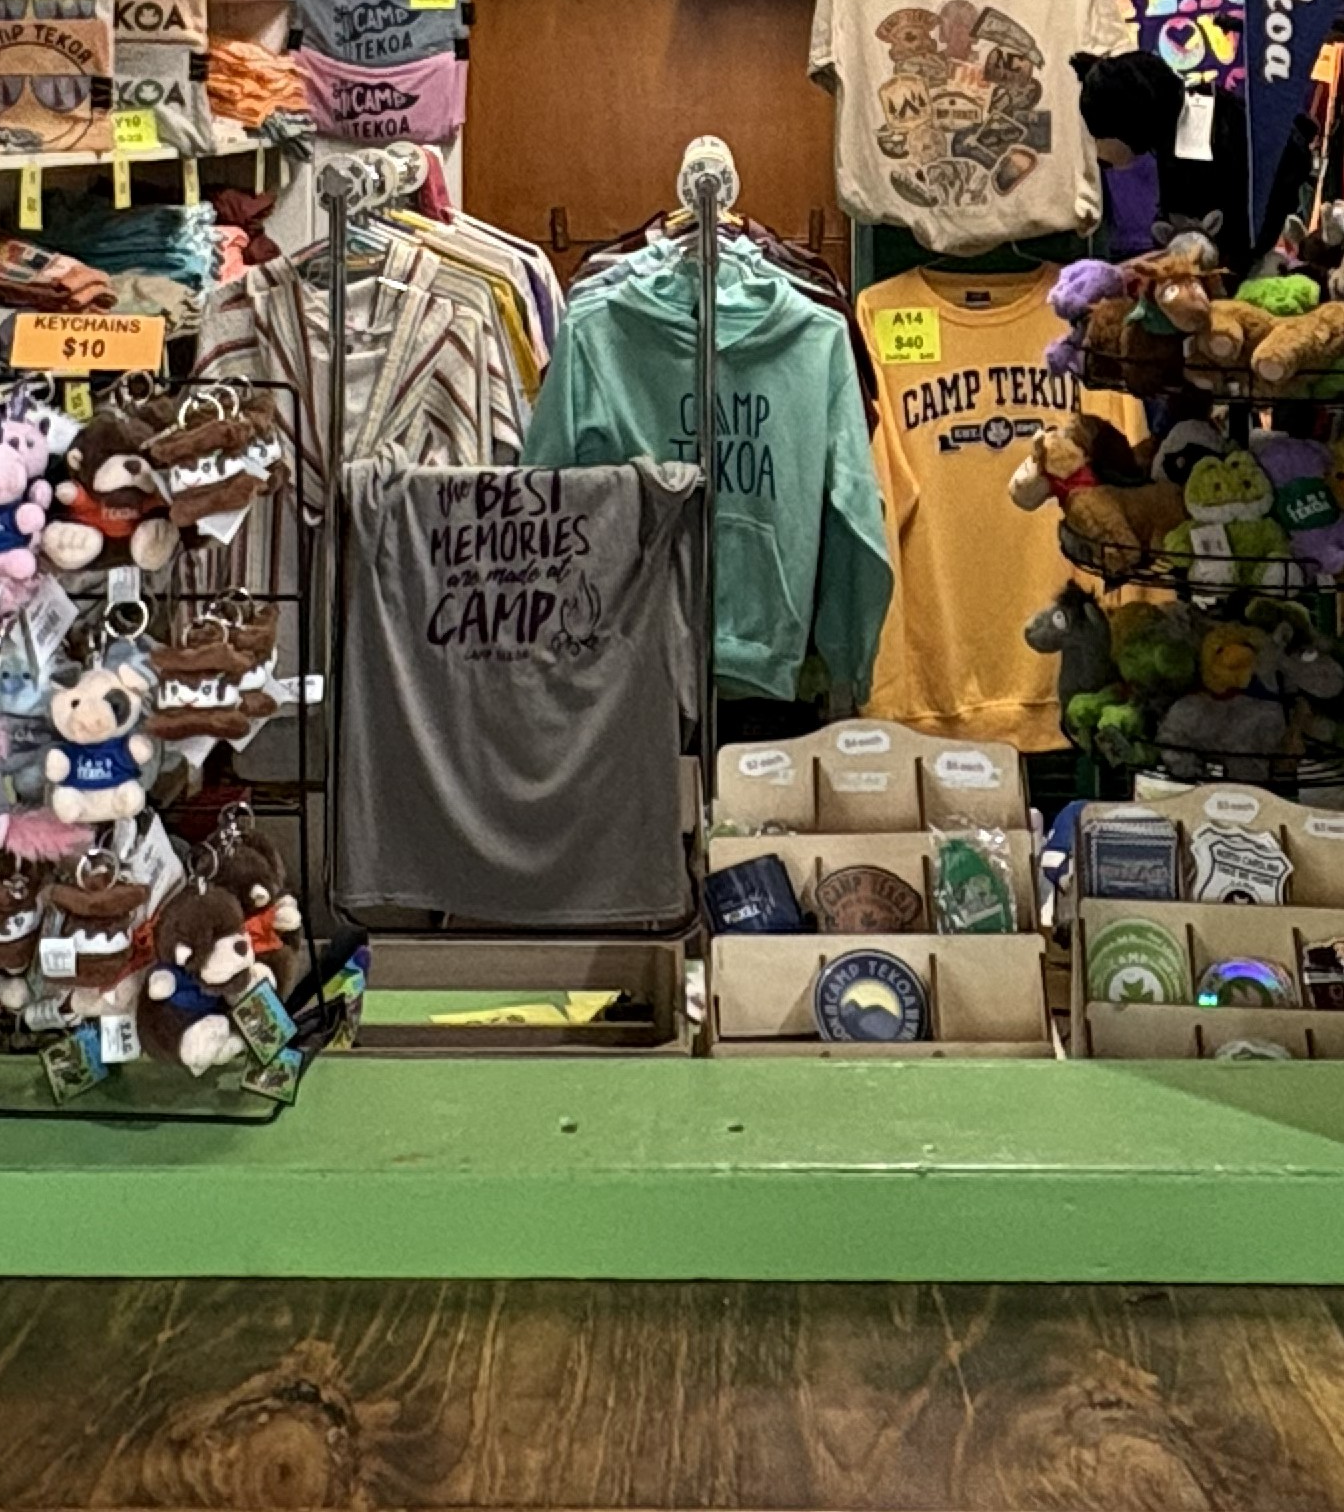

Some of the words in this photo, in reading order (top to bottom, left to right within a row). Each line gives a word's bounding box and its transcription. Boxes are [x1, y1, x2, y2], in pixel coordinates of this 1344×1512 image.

[114, 1, 187, 31] KOA
[353, 4, 409, 32] CAMP
[34, 24, 93, 64] TEKOA
[356, 31, 413, 61] TEKOA
[114, 78, 187, 106] KOA
[351, 84, 407, 112] CAMP
[352, 115, 412, 139] TEKOA
[34, 315, 142, 334] KEYCHAINS
[892, 311, 924, 326] A14
[62, 336, 106, 360] $10
[894, 334, 924, 351] $40
[902, 369, 981, 430] CAMP
[988, 366, 1081, 414] TEKOA
[680, 391, 770, 439] CAMP
[437, 475, 472, 518] the
[474, 468, 562, 520] BEST
[430, 514, 591, 567] MEMORIES
[487, 558, 541, 586] made
[427, 589, 557, 646] CAMP
[824, 962, 860, 1003] CAMP
[867, 960, 917, 1007] TEKOA
